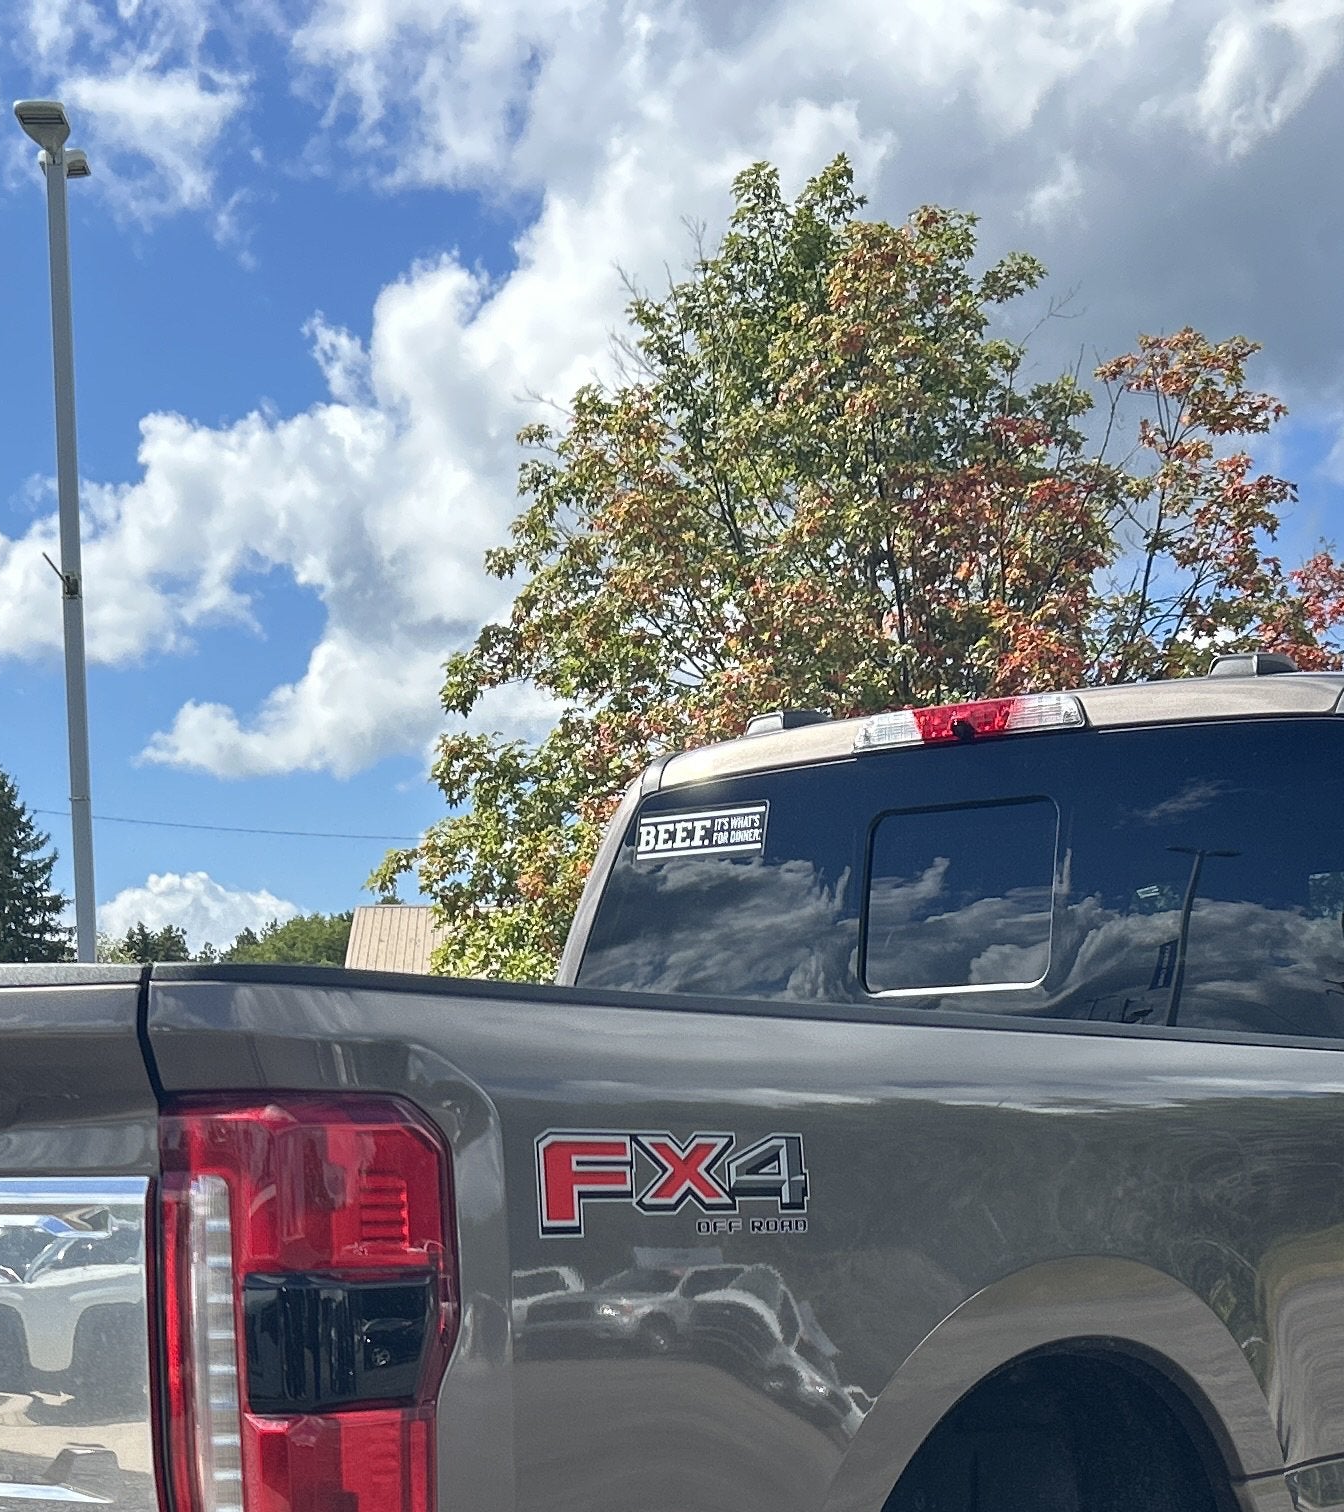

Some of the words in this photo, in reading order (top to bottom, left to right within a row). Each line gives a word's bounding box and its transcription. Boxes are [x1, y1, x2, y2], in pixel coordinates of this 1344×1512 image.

[713, 817, 730, 832] IT'S
[730, 814, 761, 830] WHAT'S
[637, 819, 712, 853] BEEF.
[712, 831, 729, 846] FOR
[534, 1128, 810, 1239] FX4
[696, 1218, 743, 1235] OFF
[749, 1217, 809, 1234] ROAD
